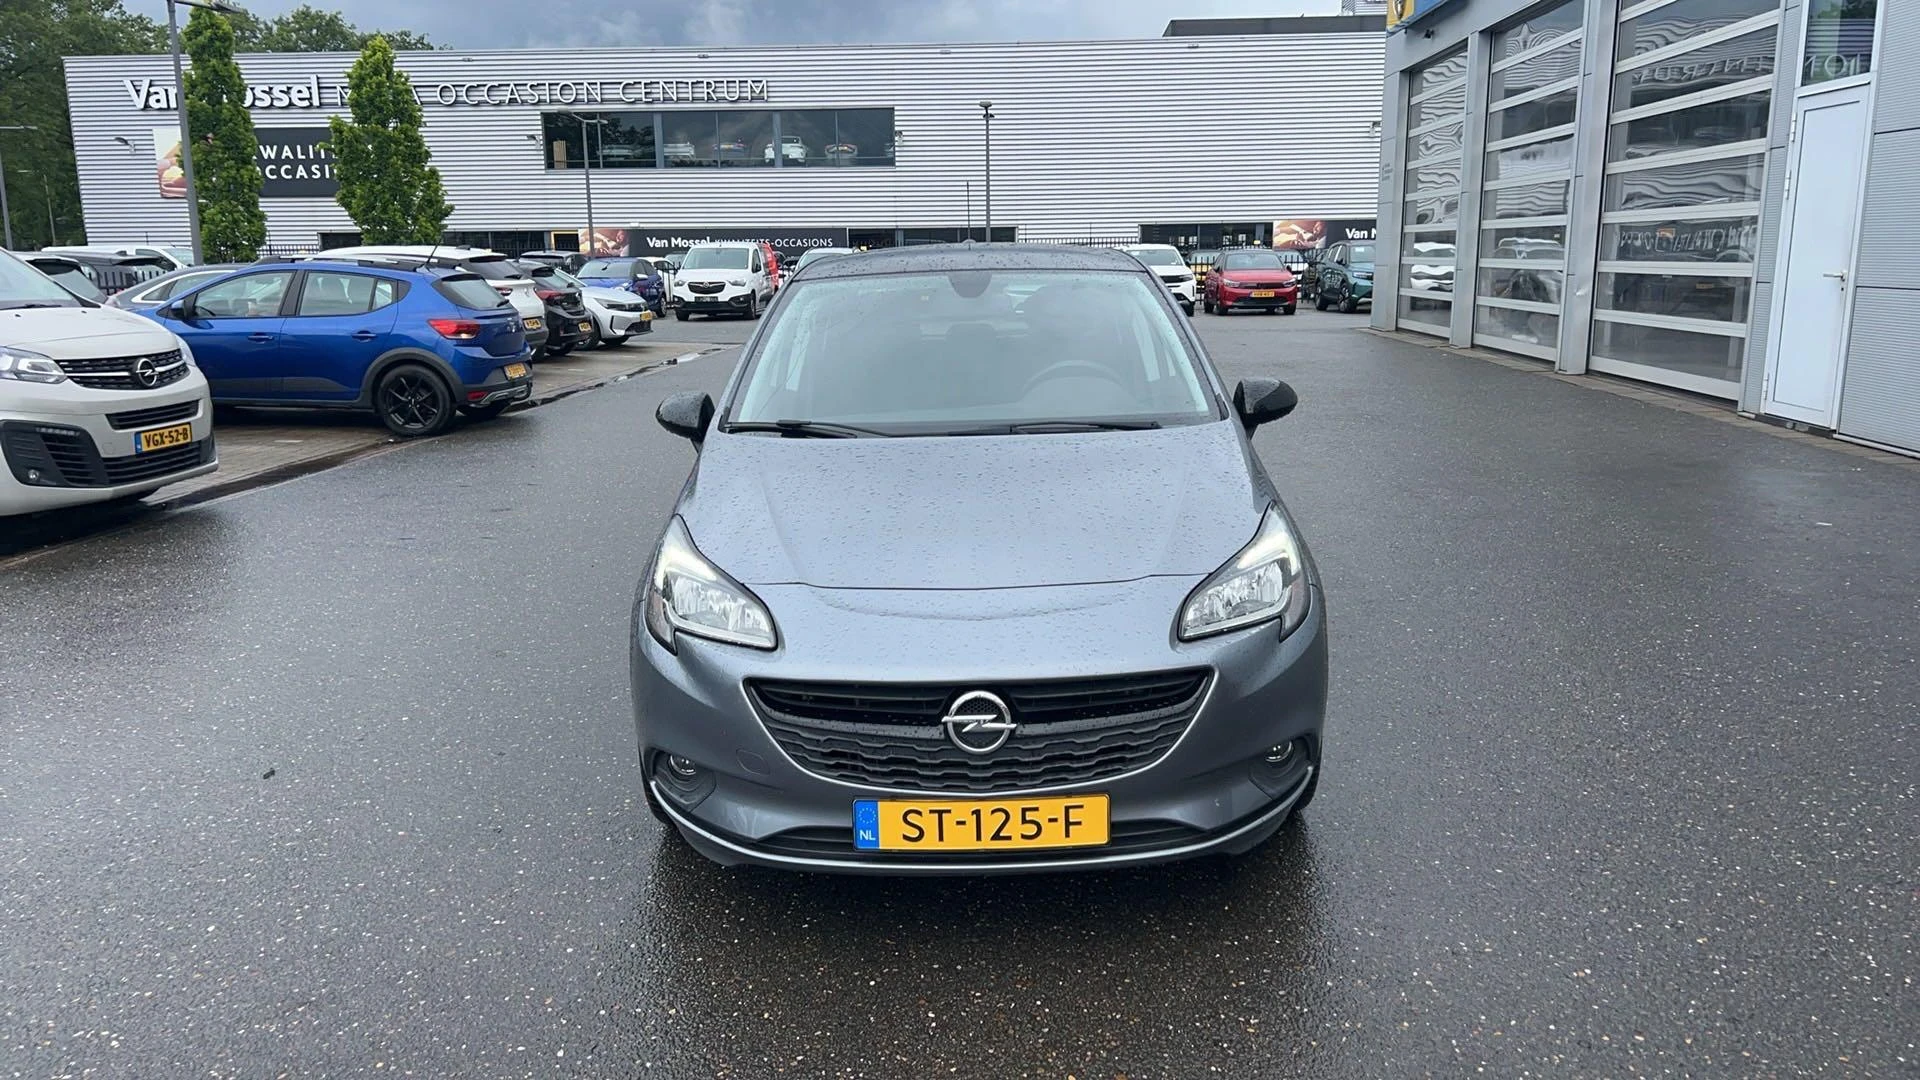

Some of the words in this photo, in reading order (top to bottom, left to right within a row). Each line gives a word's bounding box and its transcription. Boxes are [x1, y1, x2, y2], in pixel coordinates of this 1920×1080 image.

[242, 74, 320, 107] ossel
[436, 81, 602, 105] OCCASION
[619, 79, 769, 102] CENTRUM
[256, 164, 337, 179] CCASI
[646, 236, 669, 248] Van
[1345, 227, 1368, 239] Van
[144, 427, 189, 448] VGX-52-B
[859, 829, 876, 841] NL
[901, 804, 1085, 842] ST-125-F
